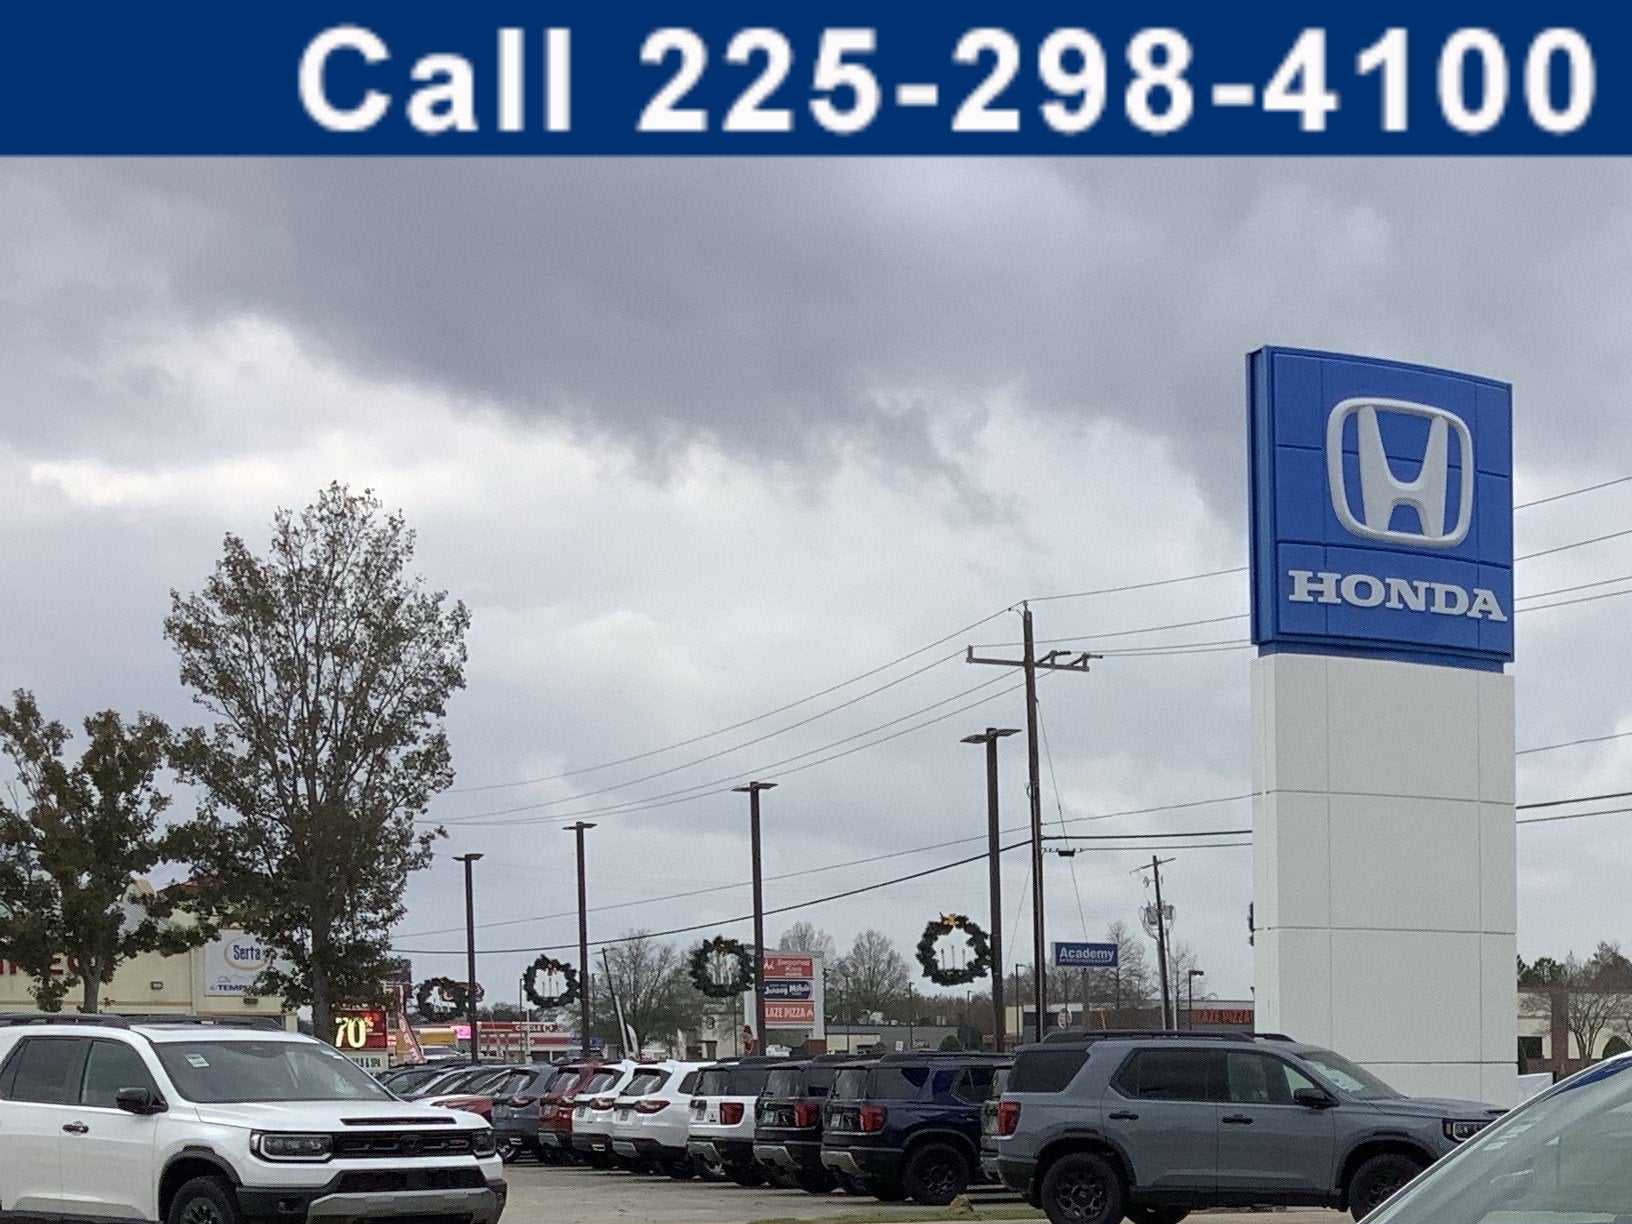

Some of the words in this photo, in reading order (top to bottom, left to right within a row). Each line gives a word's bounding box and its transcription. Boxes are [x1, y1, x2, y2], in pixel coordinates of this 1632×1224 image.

[1288, 570, 1508, 622] HONDA
[233, 944, 261, 962] Serta
[1060, 947, 1115, 962] Academy
[764, 1007, 783, 1018] LAZE
[784, 1007, 806, 1018] PIZZA
